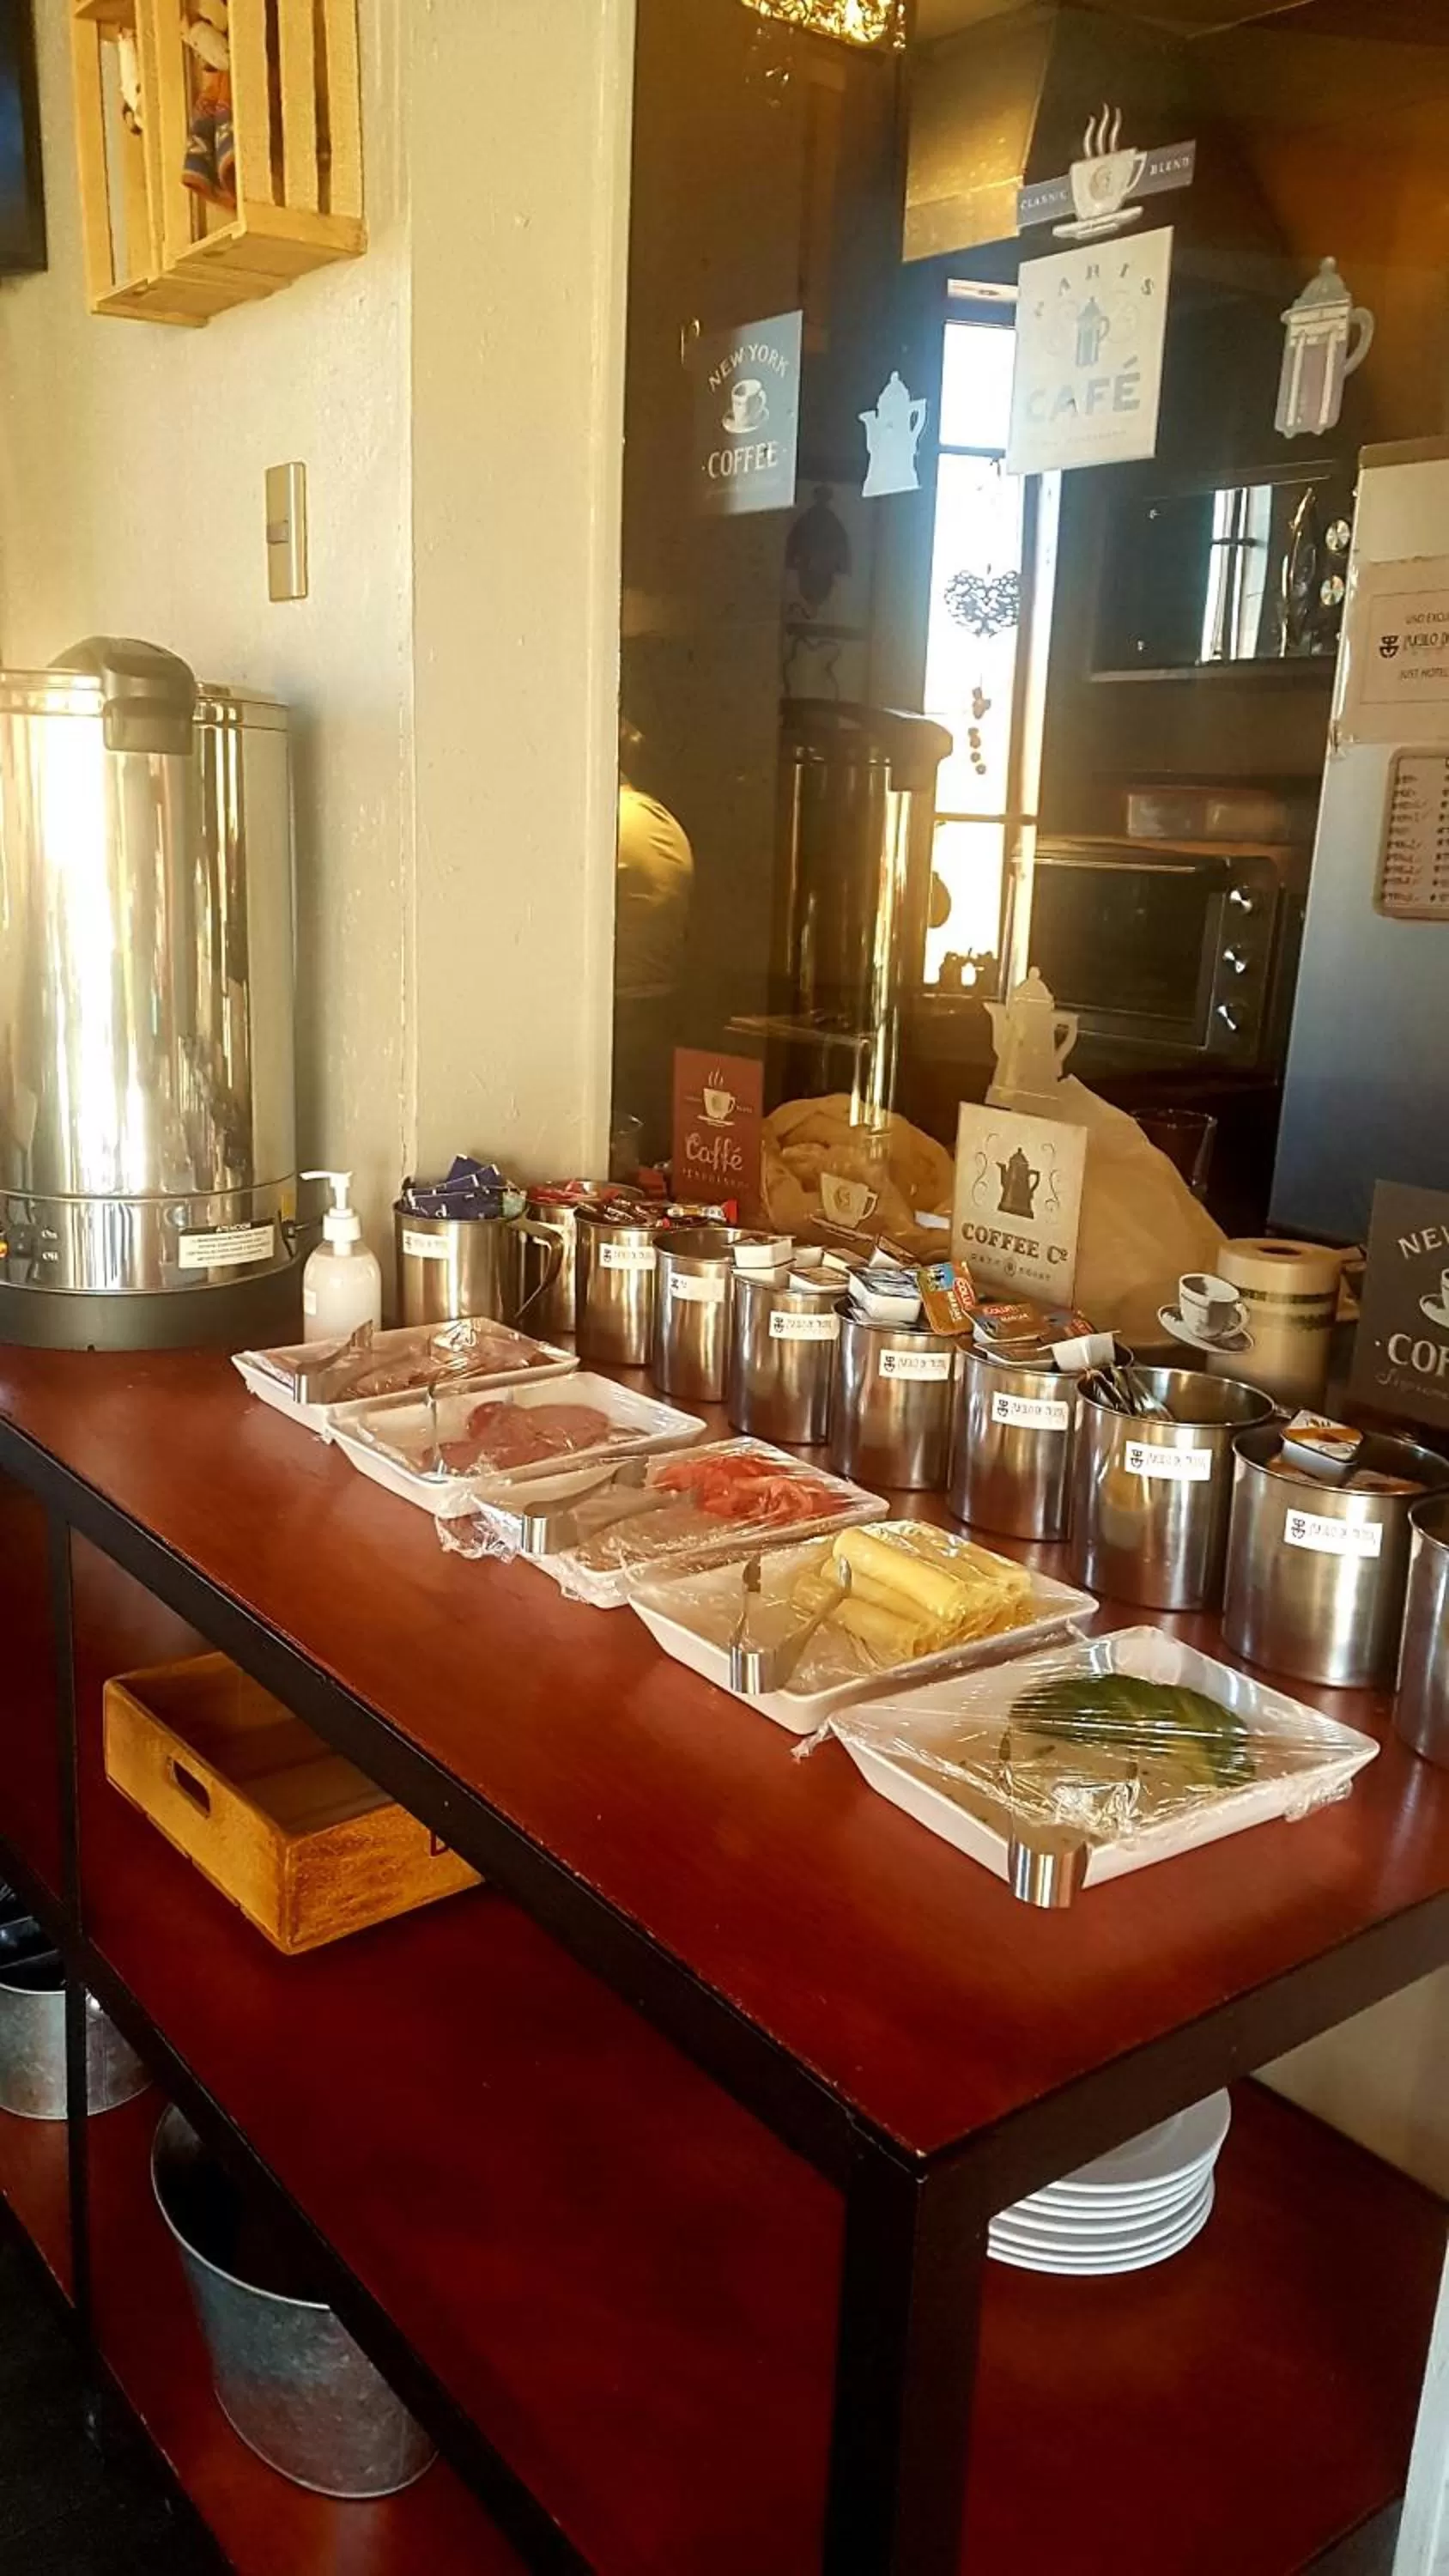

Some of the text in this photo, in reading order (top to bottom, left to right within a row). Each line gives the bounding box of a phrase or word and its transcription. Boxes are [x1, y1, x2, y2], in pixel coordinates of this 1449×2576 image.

[707, 343, 790, 393] NEW YORK
[707, 440, 779, 479] COFFEE
[961, 1223, 1040, 1259] COFFEE
